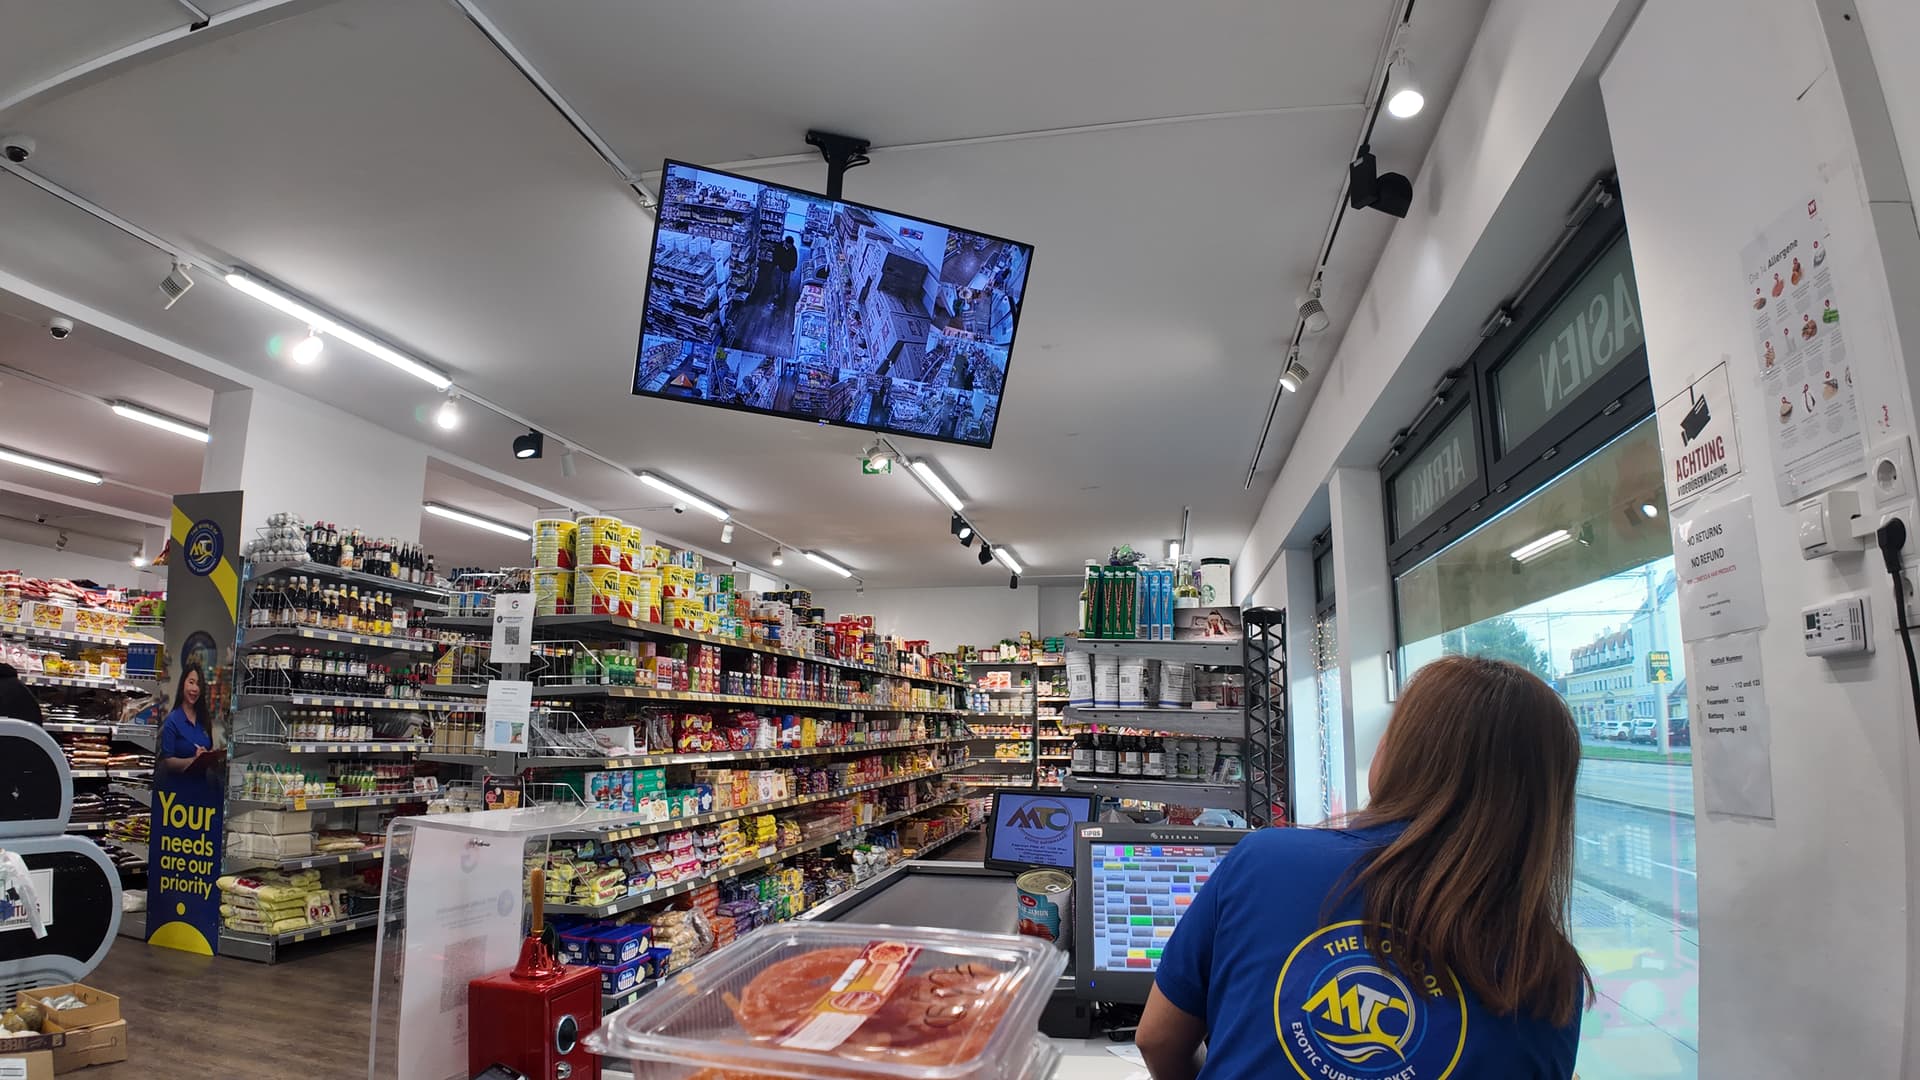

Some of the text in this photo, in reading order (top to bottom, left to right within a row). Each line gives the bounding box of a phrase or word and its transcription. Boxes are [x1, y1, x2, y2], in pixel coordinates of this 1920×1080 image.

[1768, 240, 1798, 268] Allergene
[1676, 435, 1725, 482] ACHTUNG
[605, 530, 621, 543] NID
[1696, 524, 1723, 544] RETURNS
[1691, 547, 1725, 568] NO REFUND
[158, 791, 216, 831] Your
[161, 833, 213, 857] needs
[160, 855, 213, 875] are our
[161, 873, 212, 900] priority
[1323, 936, 1360, 957] THE
[1423, 975, 1444, 998] OF
[1291, 1021, 1417, 1080] EXOTIC SUPKET
